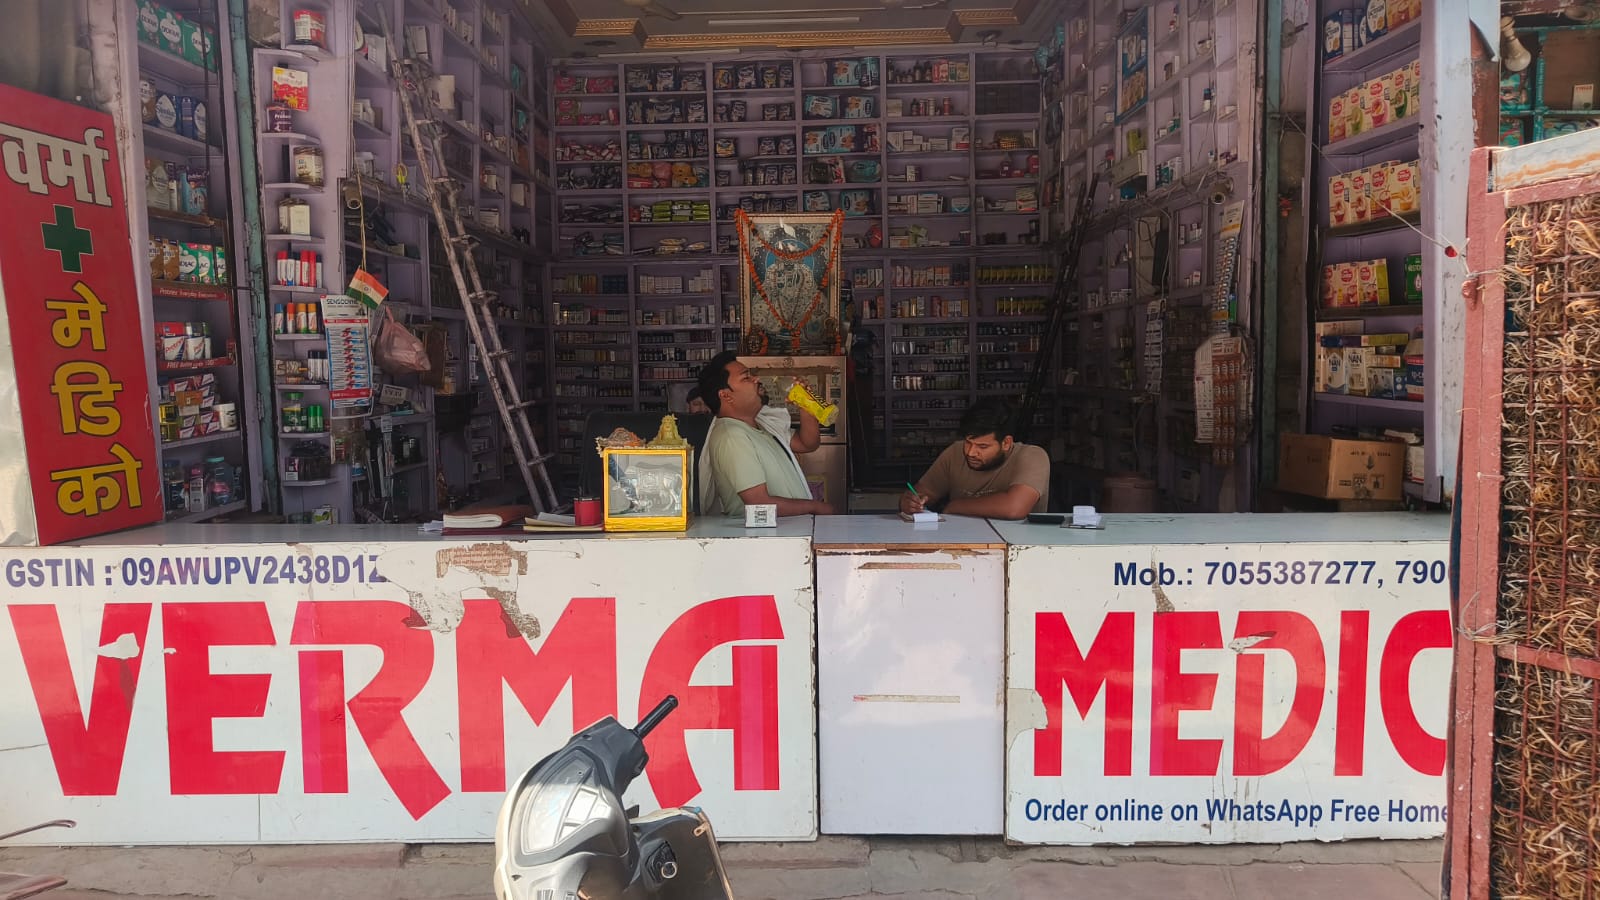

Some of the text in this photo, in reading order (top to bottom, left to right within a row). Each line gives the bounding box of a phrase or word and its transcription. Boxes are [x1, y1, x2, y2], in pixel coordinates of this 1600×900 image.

[0, 128, 113, 207] वर्मा
[6, 558, 95, 588] GSTIN
[1113, 559, 1446, 588] Mob.: 7055387277, 790
[7, 594, 784, 821] VERMA
[1033, 609, 1452, 777] MEDIC
[1025, 798, 1088, 822] Order
[1095, 798, 1164, 822] online
[1170, 804, 1199, 822] on
[1206, 798, 1323, 828] WhatsApp
[1330, 799, 1380, 822] Free
